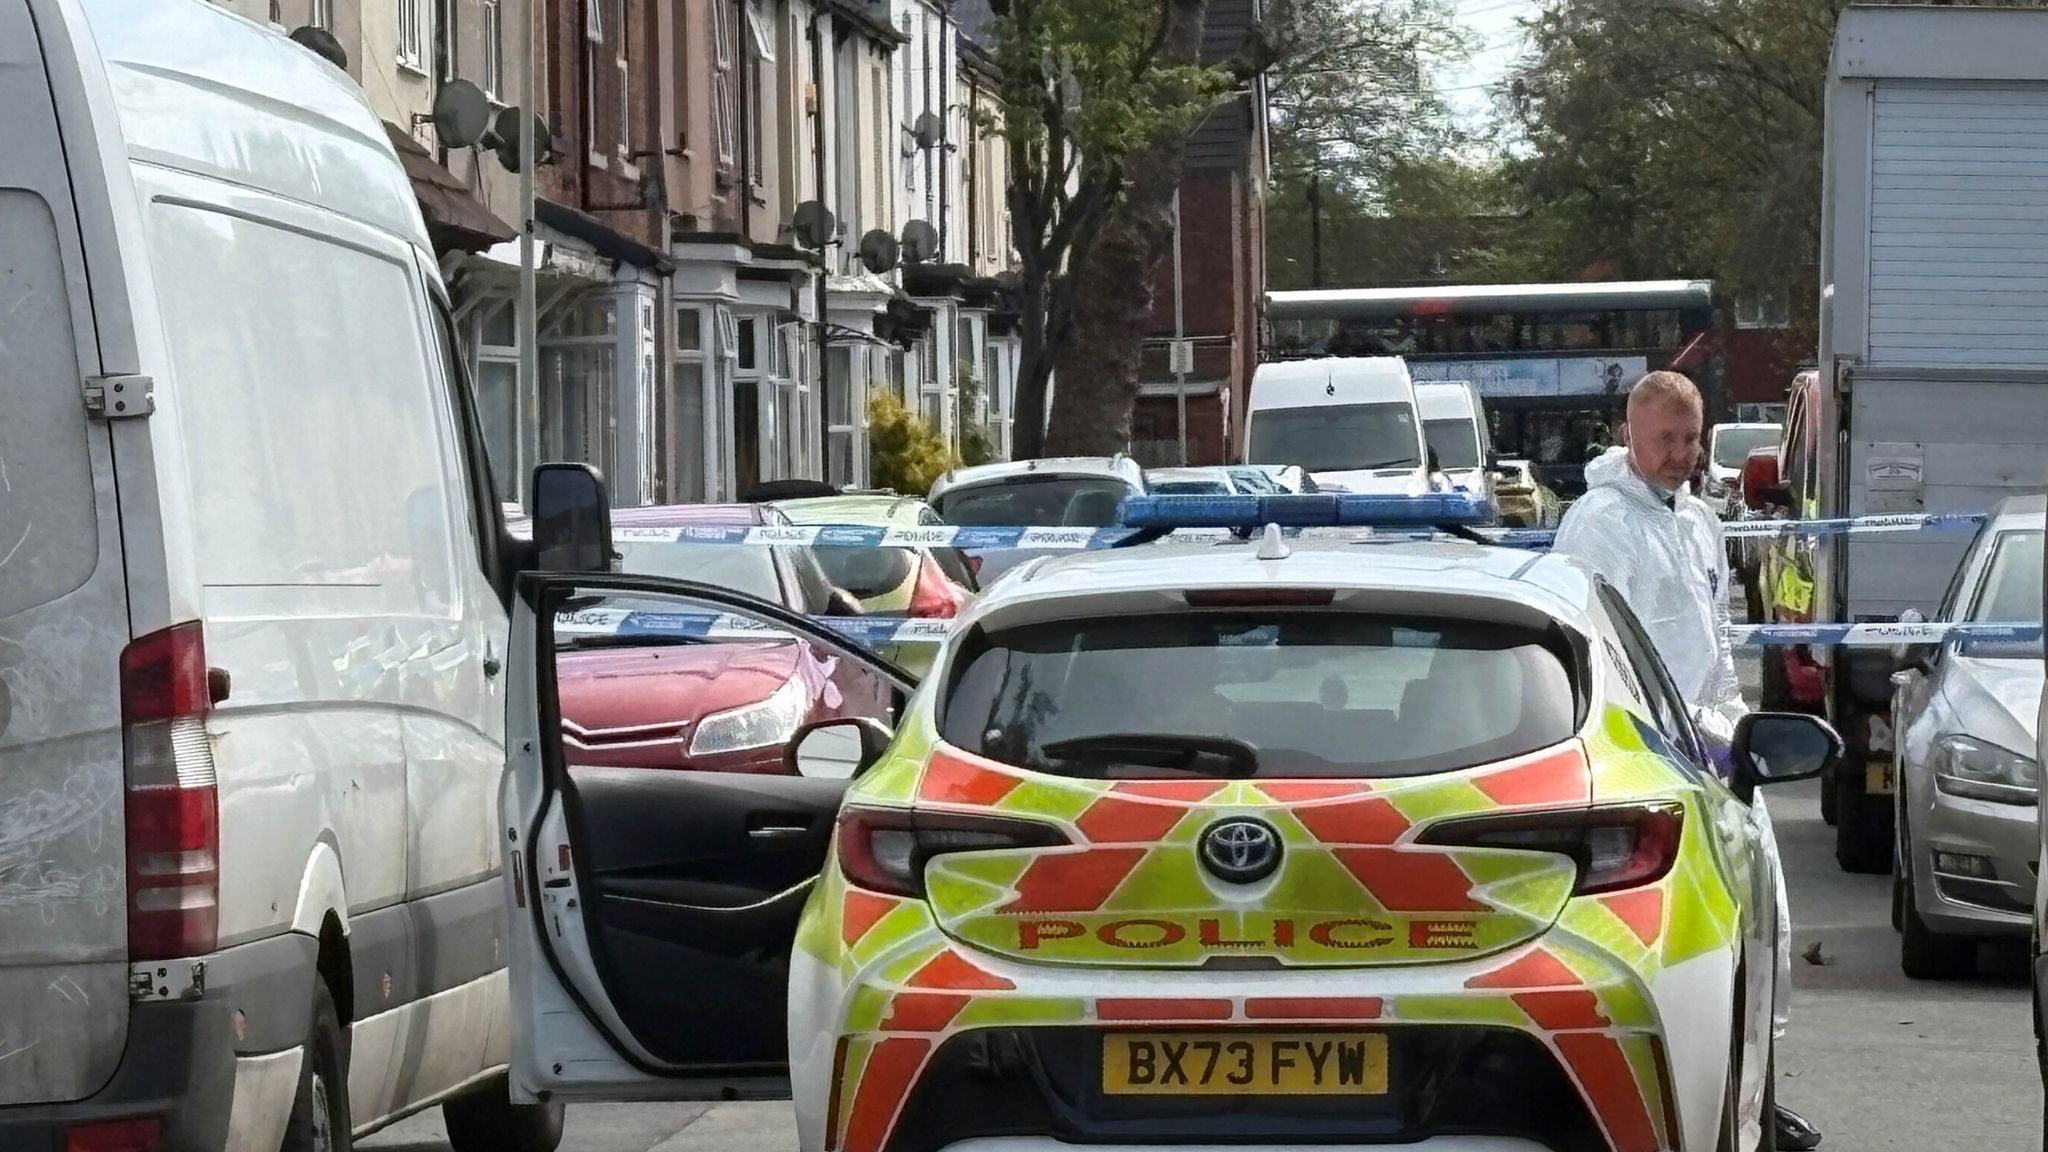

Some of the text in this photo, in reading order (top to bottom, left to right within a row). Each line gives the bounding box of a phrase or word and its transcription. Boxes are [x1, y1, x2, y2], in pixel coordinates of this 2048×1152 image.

[1018, 918, 1480, 951] POLICE
[1127, 1040, 1367, 1086] BX73 FYW
